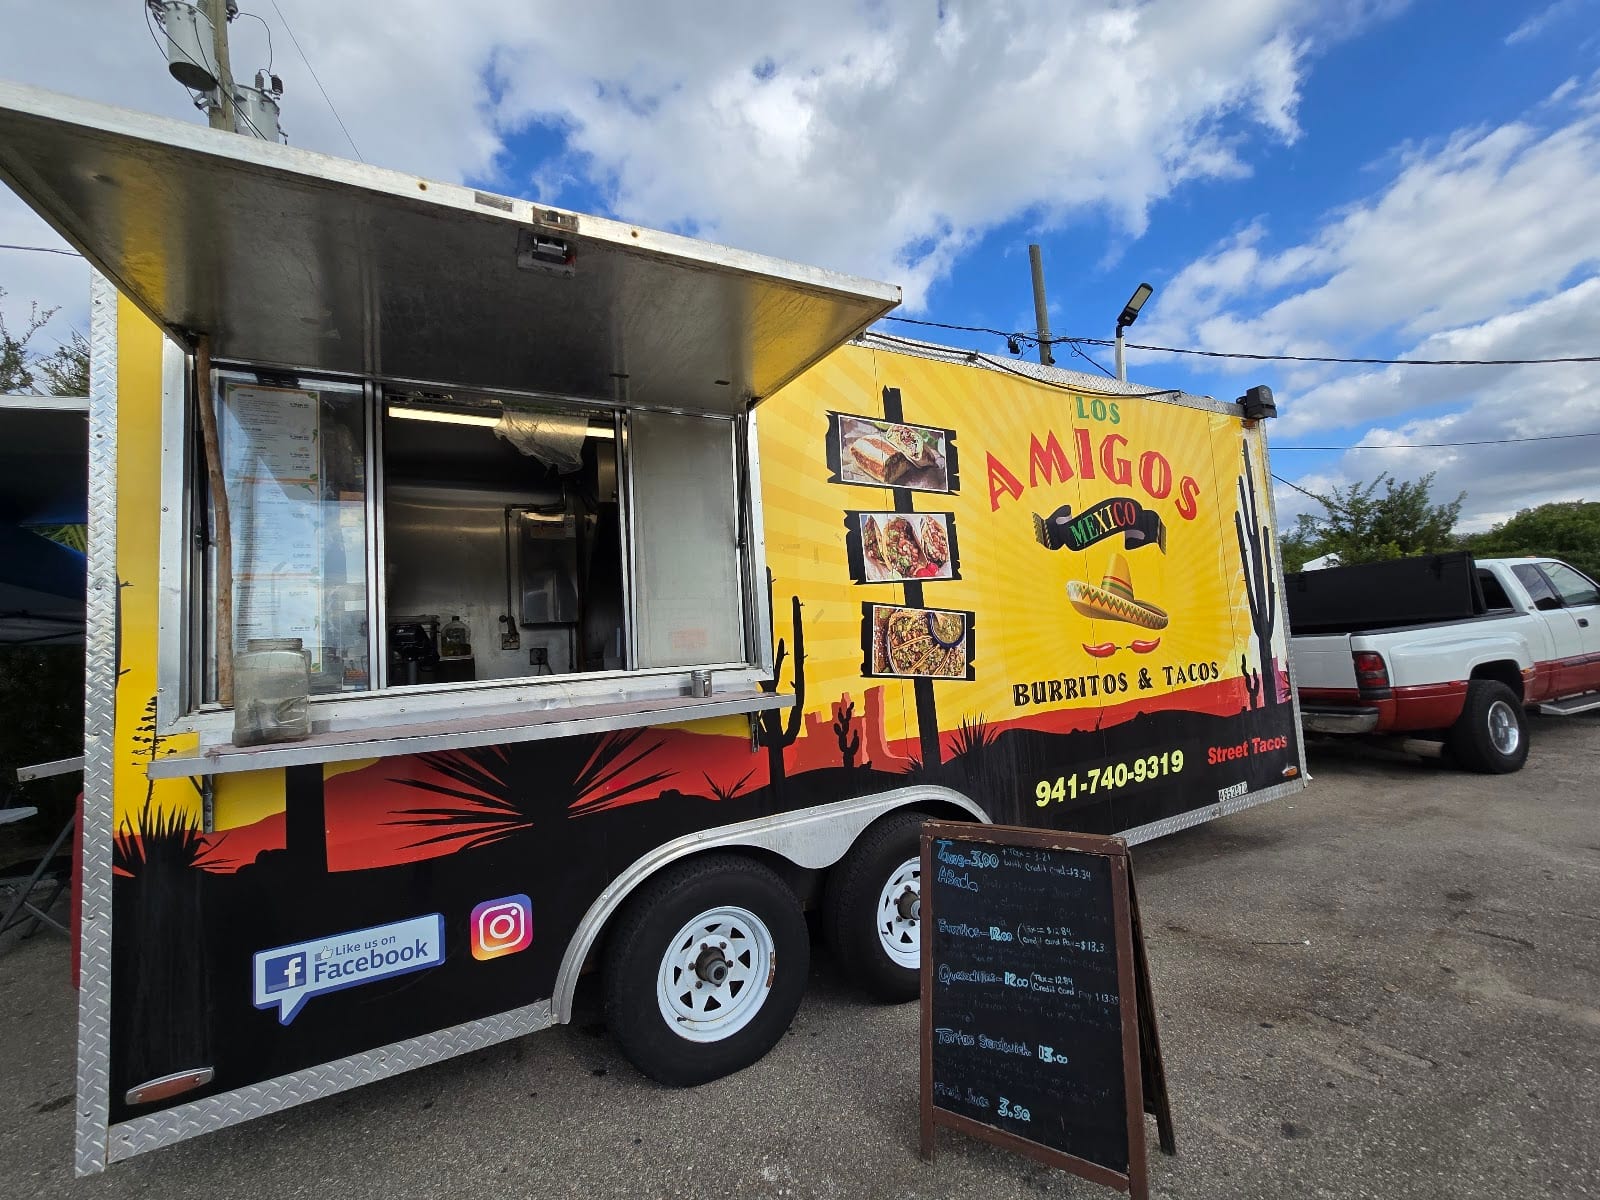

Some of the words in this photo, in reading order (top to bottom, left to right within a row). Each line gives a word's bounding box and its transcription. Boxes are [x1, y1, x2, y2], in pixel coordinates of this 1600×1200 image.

[1076, 397, 1120, 424] LOS
[986, 428, 1200, 520] AMIGOS
[1069, 501, 1136, 547] MEXICO
[1013, 672, 1128, 706] BURRITOS
[1138, 667, 1153, 689] &
[1162, 661, 1219, 686] TACOS
[1208, 741, 1249, 765] Street
[1252, 736, 1287, 754] Tacos
[1035, 750, 1184, 807] 941-740-9319
[314, 939, 428, 984] Facebook
[336, 942, 361, 956] Like
[364, 939, 378, 950] us
[381, 935, 396, 946] on
